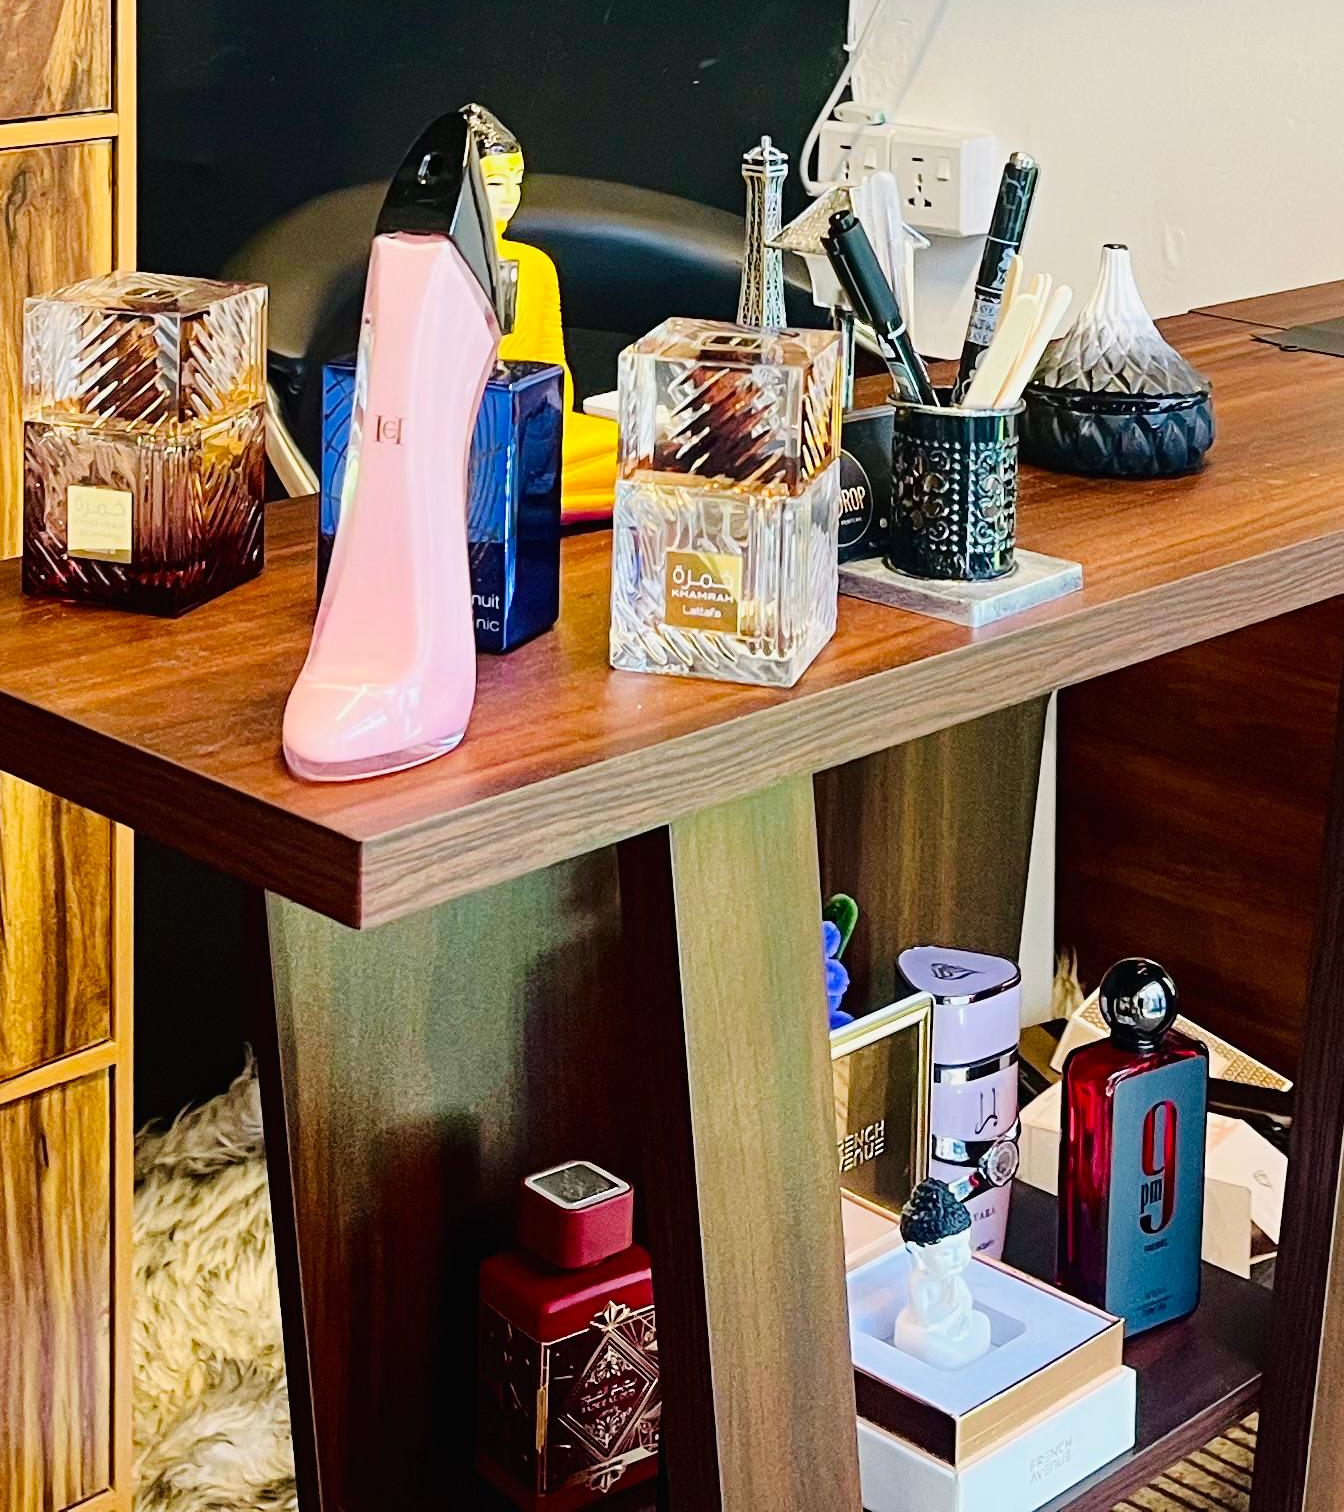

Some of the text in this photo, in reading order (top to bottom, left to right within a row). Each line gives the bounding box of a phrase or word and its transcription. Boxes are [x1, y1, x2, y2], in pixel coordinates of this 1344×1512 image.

[471, 593, 500, 609] nuit
[671, 589, 734, 604] KHAMRAH
[1139, 1099, 1178, 1236] 9
[1140, 1176, 1163, 1215] pm
